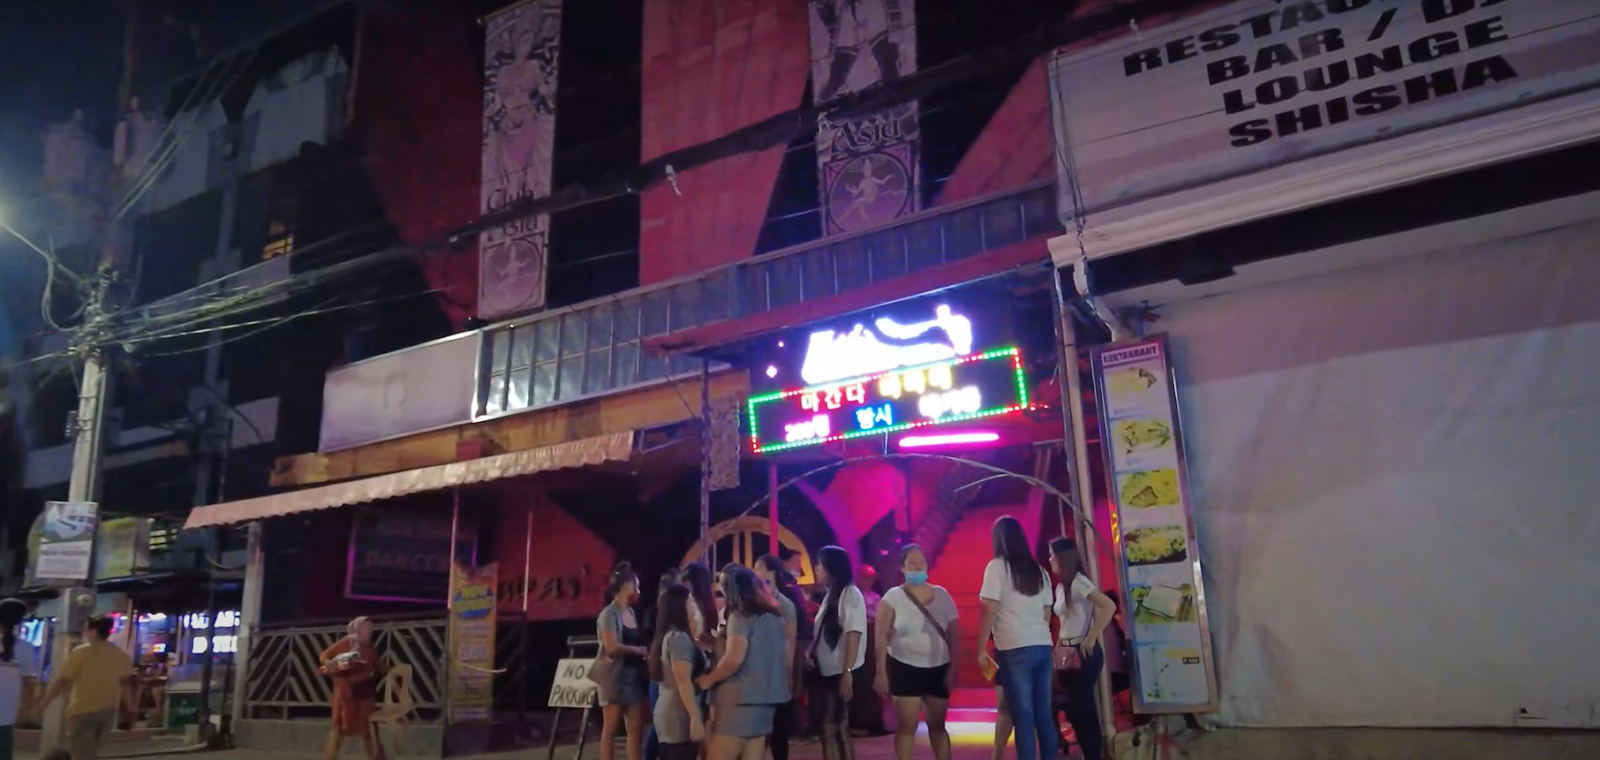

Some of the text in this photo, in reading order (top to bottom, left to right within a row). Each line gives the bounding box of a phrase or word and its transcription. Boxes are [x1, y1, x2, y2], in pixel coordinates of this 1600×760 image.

[1206, 27, 1346, 86] BAR
[1223, 15, 1509, 115] LOUNGE
[1229, 55, 1519, 148] SHISHA
[1103, 345, 1157, 363] RESTAURANT
[563, 664, 585, 680] NO
